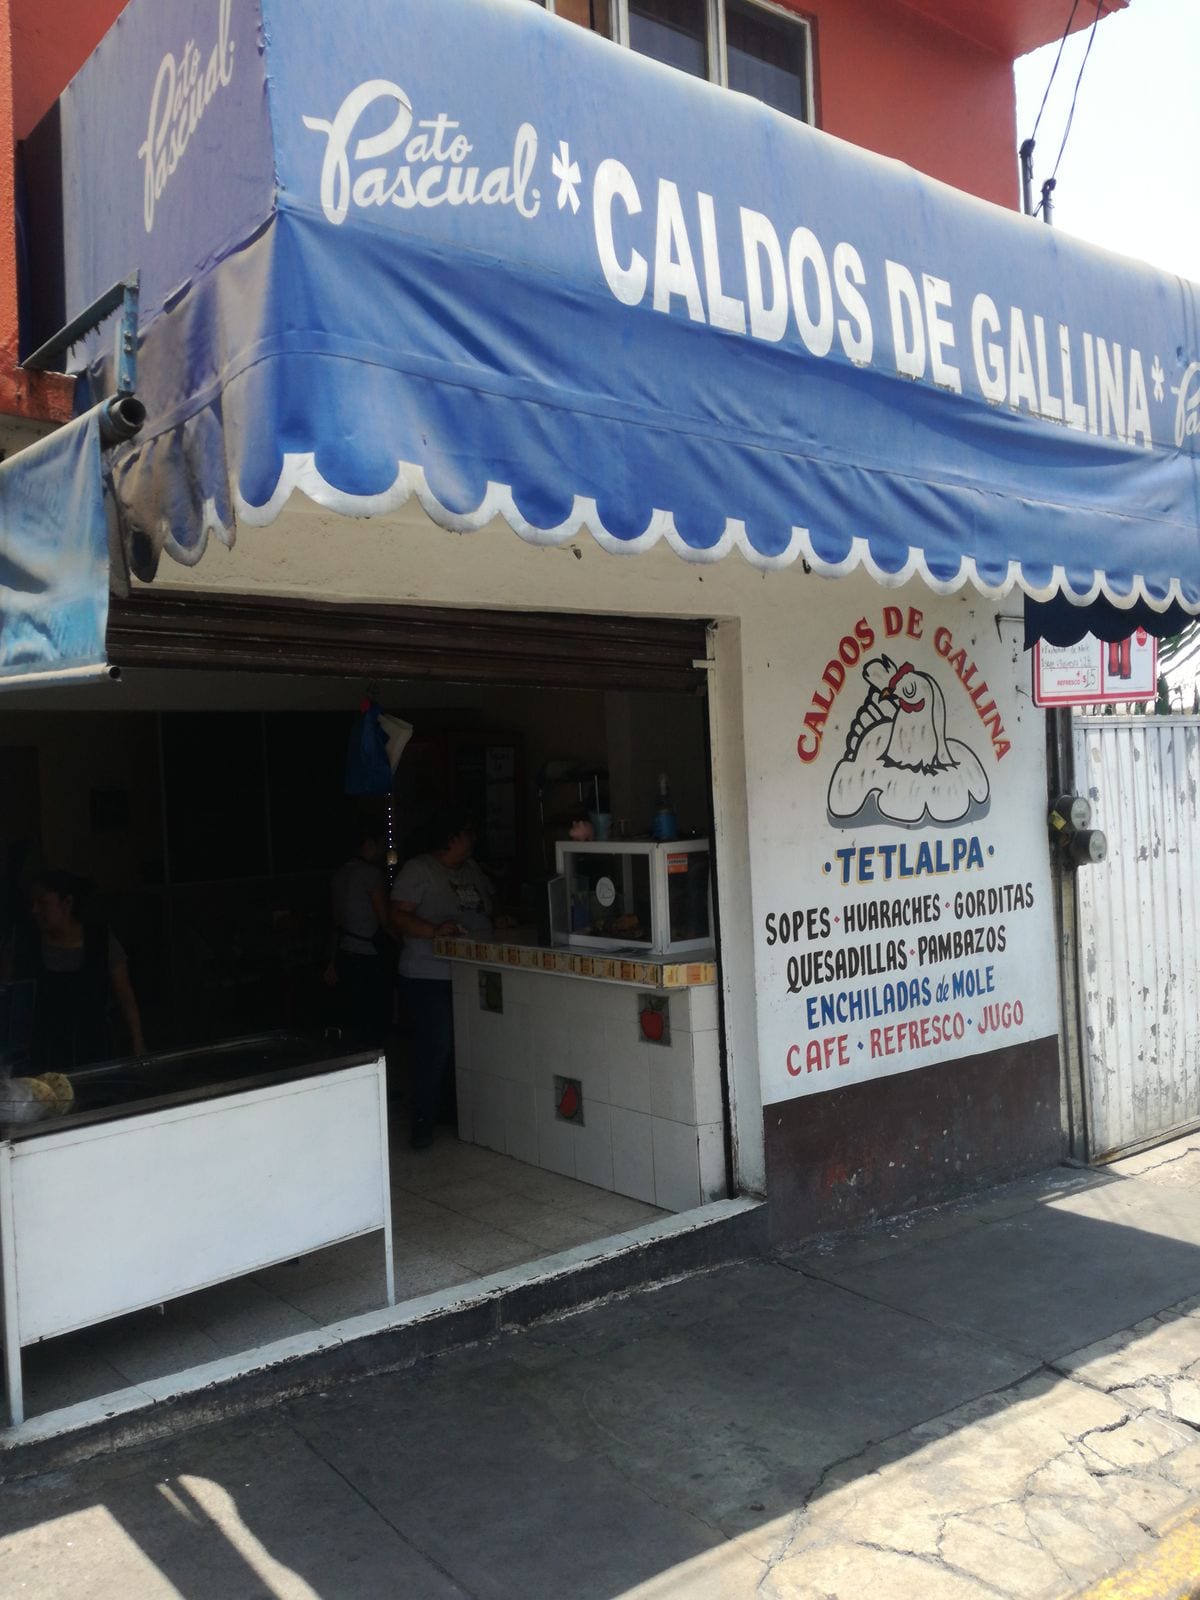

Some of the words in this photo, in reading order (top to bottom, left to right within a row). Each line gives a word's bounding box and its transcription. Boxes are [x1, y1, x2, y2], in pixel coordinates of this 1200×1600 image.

[593, 158, 874, 368] CALDOS
[885, 259, 962, 394] DE
[971, 292, 1153, 450] GALLINA
[797, 616, 875, 765] CALDOS
[882, 606, 924, 640] DE
[934, 626, 1012, 763] GALLINA
[834, 836, 985, 886] TETLALPA
[765, 906, 831, 946] SOPES
[843, 893, 941, 934] HUARACHES
[953, 882, 1034, 920] GORDITAS
[786, 939, 908, 993] QUESADILLAS
[917, 925, 1006, 967] PAMBAZOS
[806, 976, 932, 1030] ENCHILADAS
[935, 974, 950, 1003] de
[952, 965, 995, 1000] MOLE
[786, 1034, 850, 1076] CAFE
[871, 1012, 964, 1059] REFRESCO
[977, 1000, 1024, 1034] JUGO
